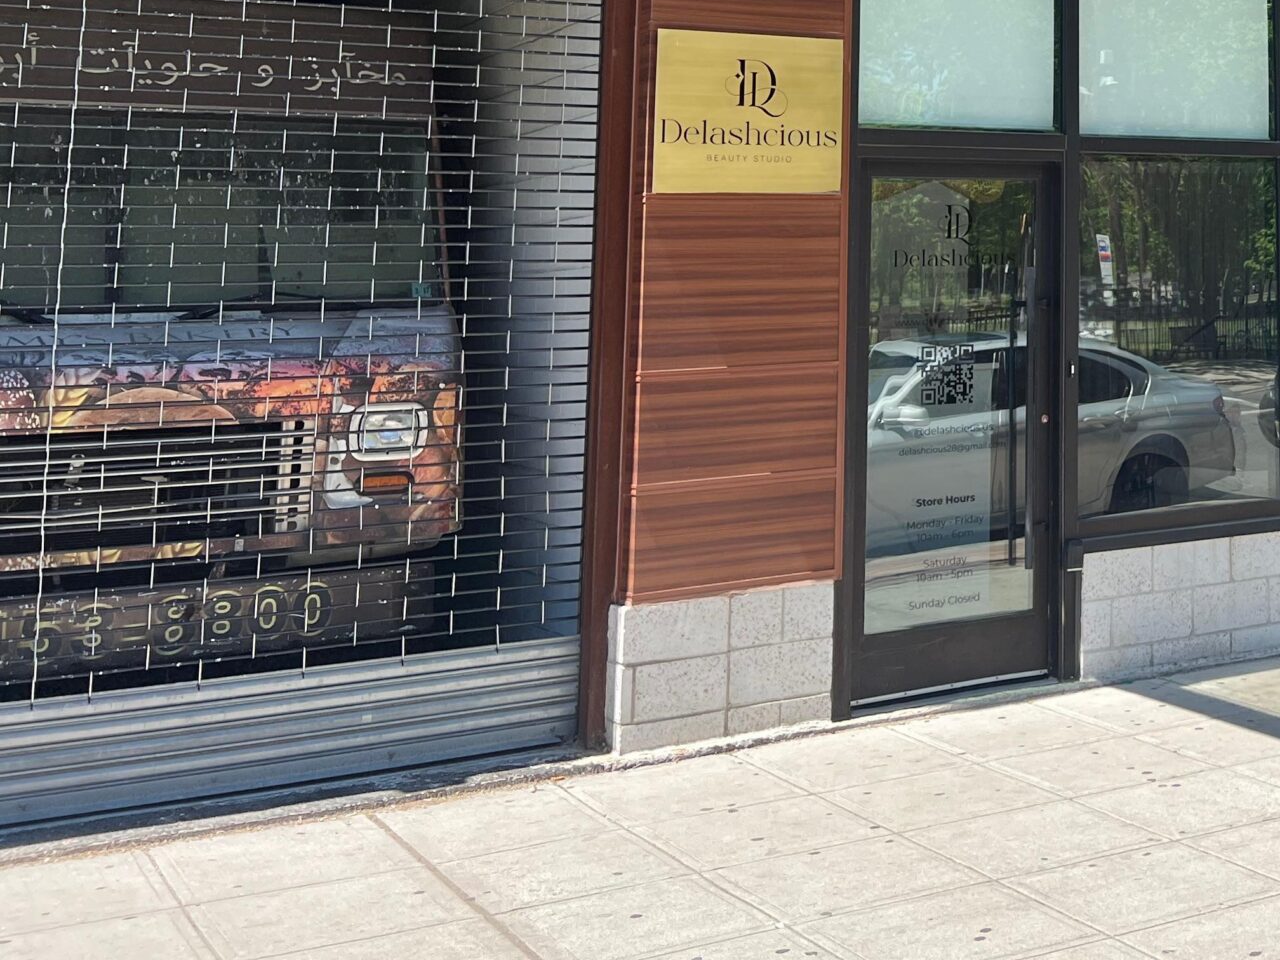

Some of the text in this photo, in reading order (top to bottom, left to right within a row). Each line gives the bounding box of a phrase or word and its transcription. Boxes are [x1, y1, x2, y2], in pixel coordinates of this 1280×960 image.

[251, 64, 274, 87] و
[660, 118, 837, 148] Delashcious
[706, 154, 792, 163] BEAUTY STUDIO
[893, 249, 1016, 268] Delashcious
[916, 494, 976, 507] Store Hours
[906, 519, 946, 530] Monday
[954, 514, 984, 526] Friday
[922, 556, 967, 568] Saturday
[916, 572, 943, 582] 10am
[951, 568, 973, 579] 5pm
[908, 592, 980, 611] Sunday Closed
